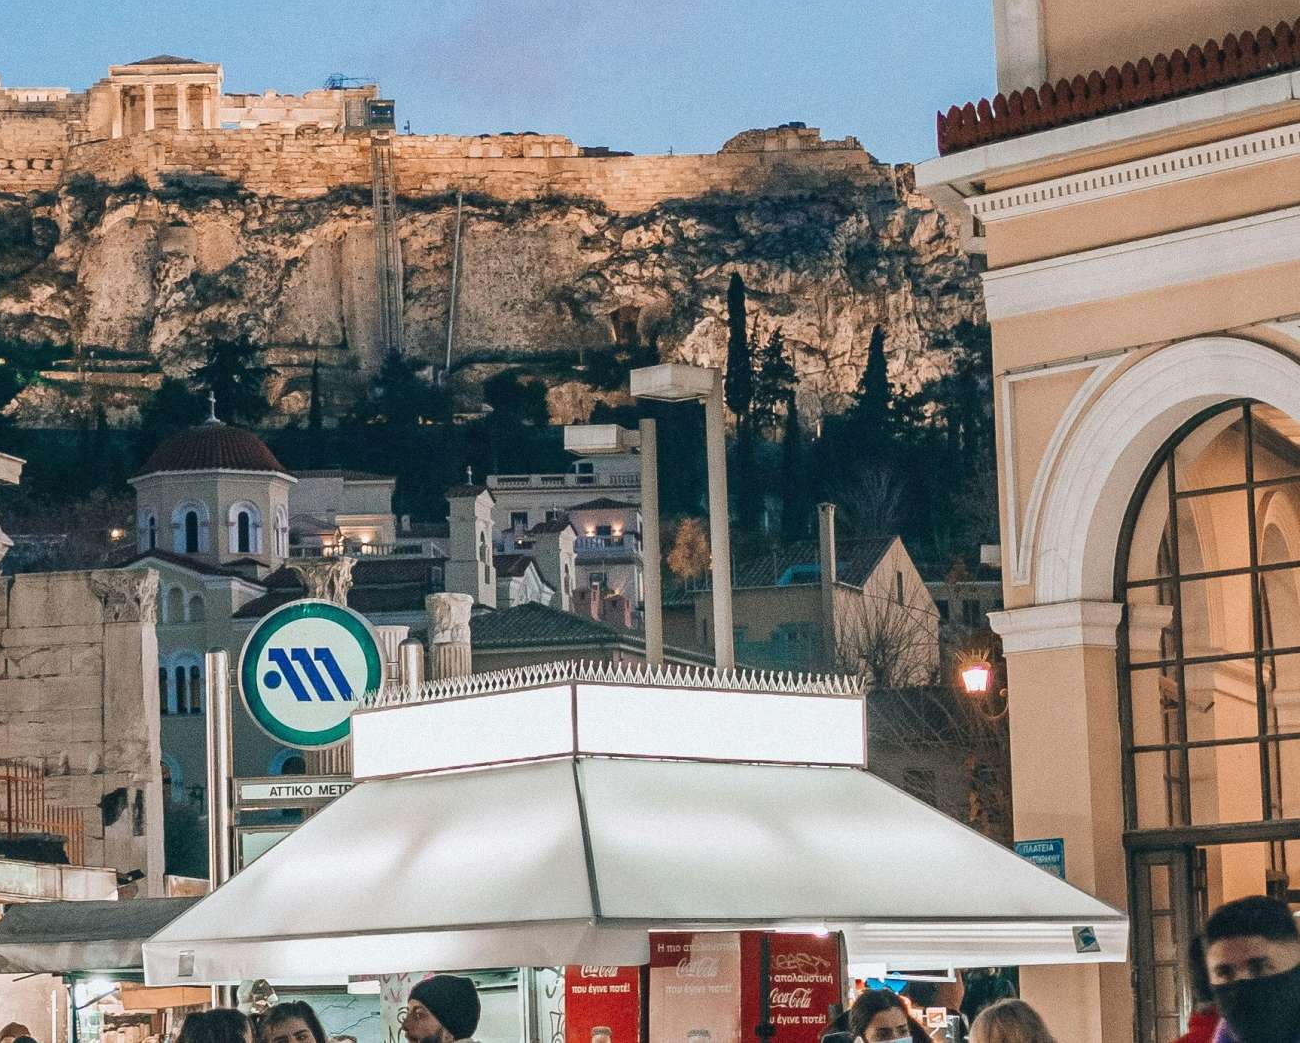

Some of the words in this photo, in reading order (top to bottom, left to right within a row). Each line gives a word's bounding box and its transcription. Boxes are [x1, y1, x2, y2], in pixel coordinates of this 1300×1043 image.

[269, 786, 312, 796] ΑΤΤΙΚΟ
[318, 784, 353, 796] ΜΕΤΡ
[1023, 844, 1053, 853] ΠΛΑΤΕΙΑ
[774, 973, 833, 984] απολαυστική
[571, 985, 587, 993] που
[588, 983, 608, 995] έγινε
[609, 982, 630, 993] ποτέ!
[777, 1014, 800, 1025] έγινε
[802, 1015, 826, 1024] ποτέ!
